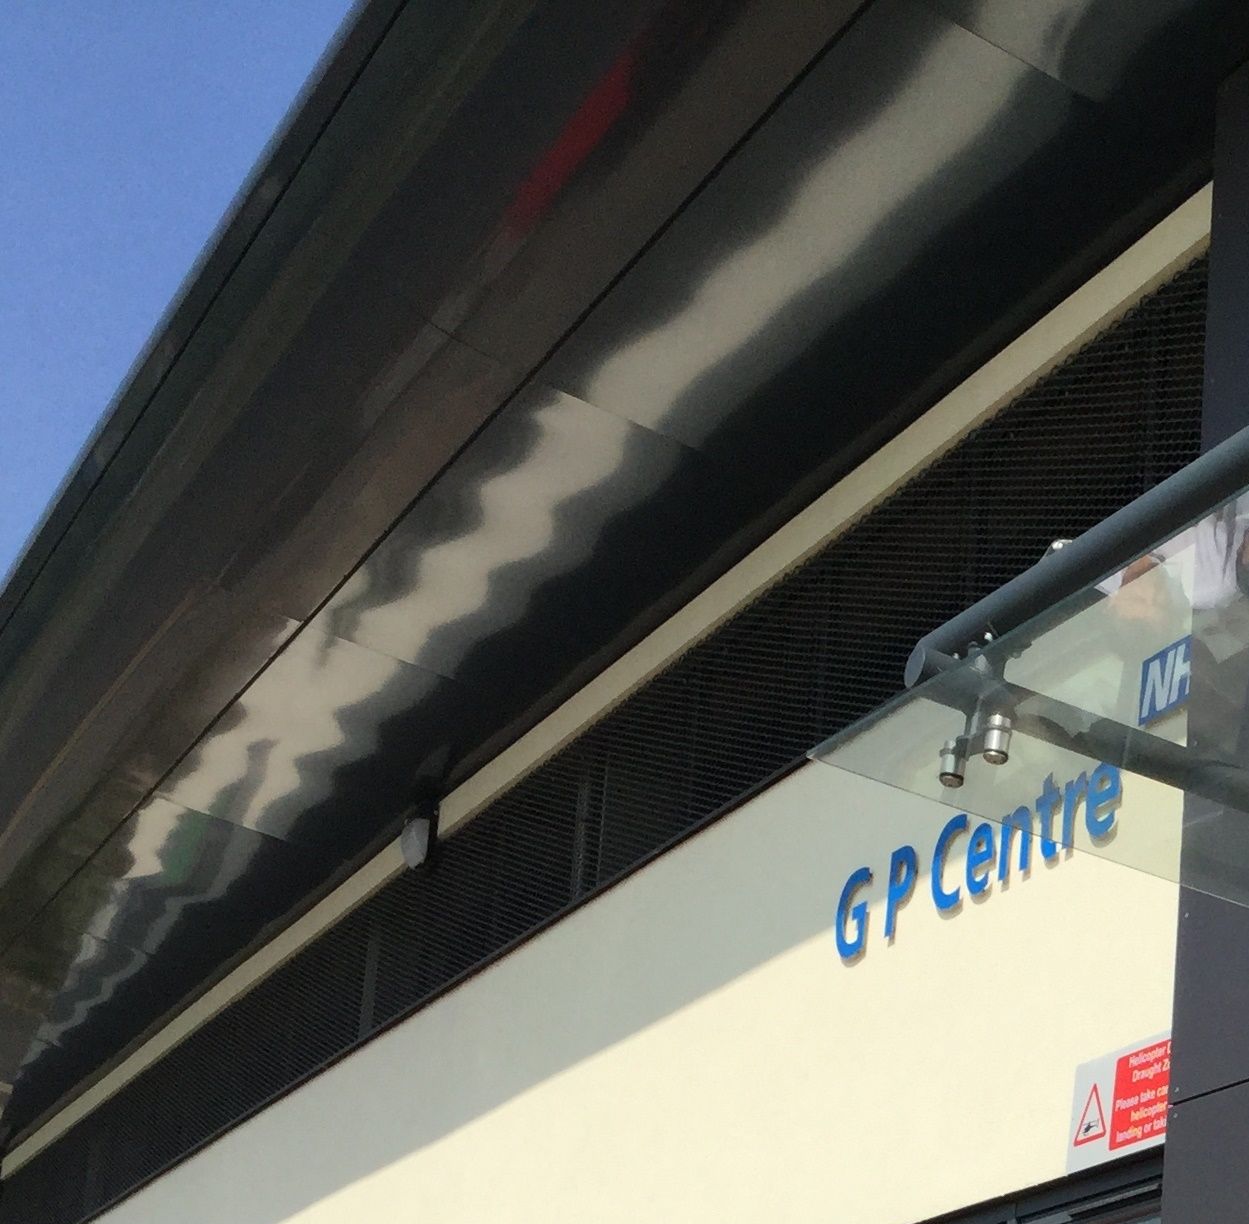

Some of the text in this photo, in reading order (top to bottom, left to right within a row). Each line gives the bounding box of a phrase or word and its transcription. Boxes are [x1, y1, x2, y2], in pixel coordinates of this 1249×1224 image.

[1141, 642, 1191, 719] NH
[932, 761, 1122, 911] Centre
[1115, 1095, 1139, 1112] Please
[1140, 1088, 1155, 1102] take
